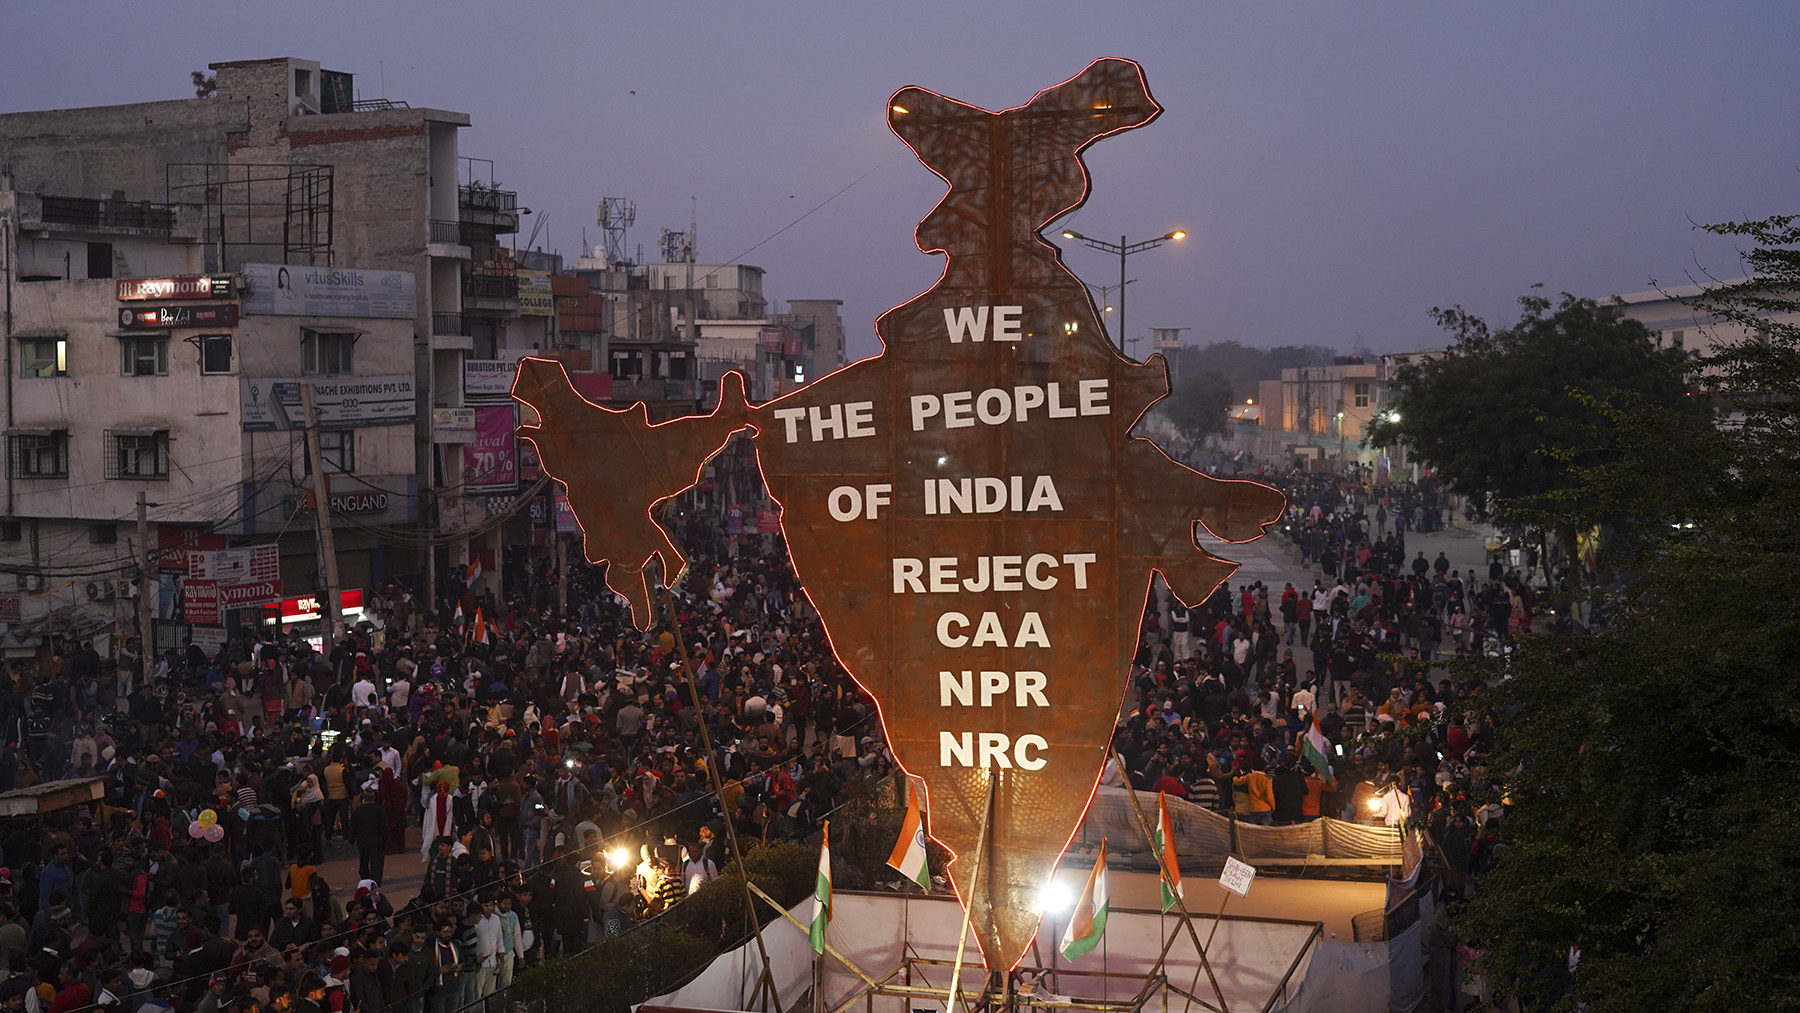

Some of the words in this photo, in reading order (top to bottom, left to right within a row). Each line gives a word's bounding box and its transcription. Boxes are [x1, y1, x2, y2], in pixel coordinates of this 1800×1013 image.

[136, 279, 210, 297] Raymond
[944, 306, 1022, 343] WE
[340, 384, 382, 395] EXHIBITIONS
[774, 402, 875, 443] THE
[911, 379, 1110, 431] PEOPLE
[331, 494, 388, 512] ENGLAND
[828, 484, 891, 521] OF
[925, 476, 1063, 514] INDIA
[893, 554, 1095, 593] REJECT
[937, 612, 1050, 648] CAA
[940, 671, 1050, 707] NPR
[940, 732, 1048, 770] NRC
